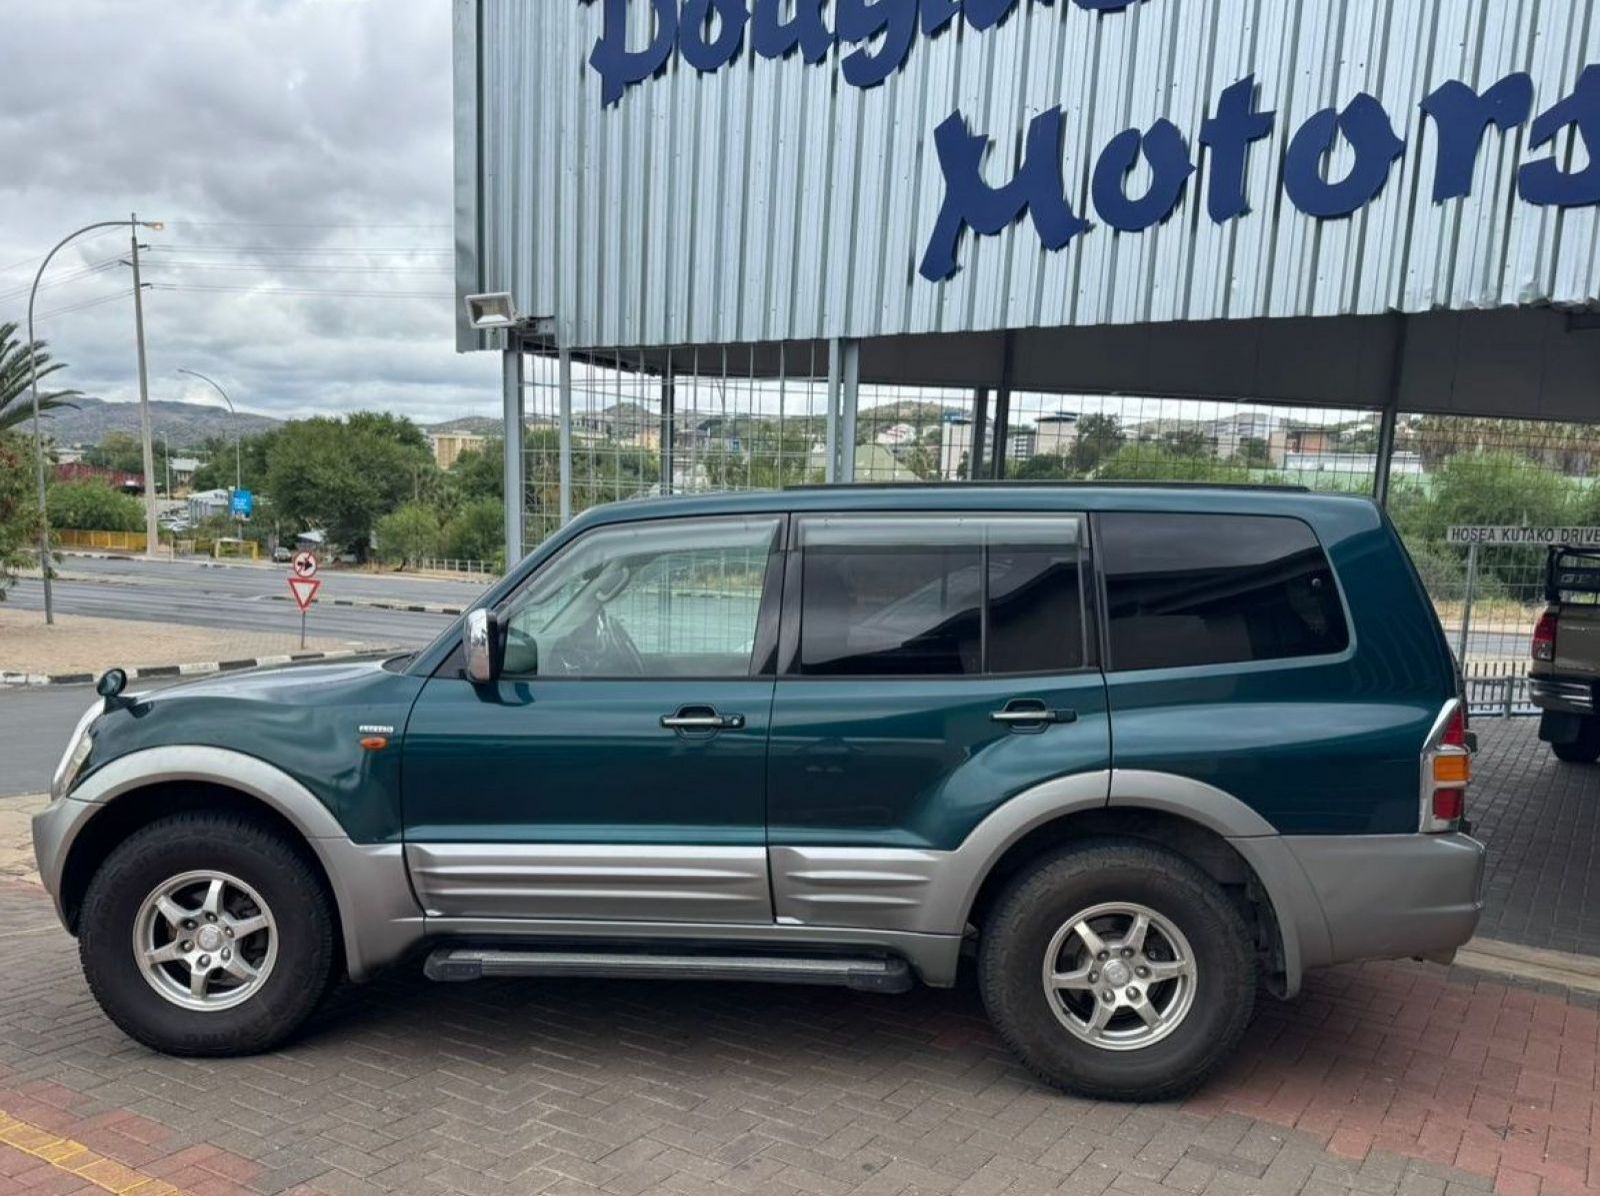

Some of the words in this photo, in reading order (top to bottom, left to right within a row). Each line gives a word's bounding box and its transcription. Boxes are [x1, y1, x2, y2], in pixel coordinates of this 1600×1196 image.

[589, 0, 1145, 105] Doug
[919, 64, 1600, 282] Motors
[1452, 527, 1495, 542] HOSEA
[1502, 527, 1554, 542] KUTAKO
[1561, 527, 1600, 543] DRIVE
